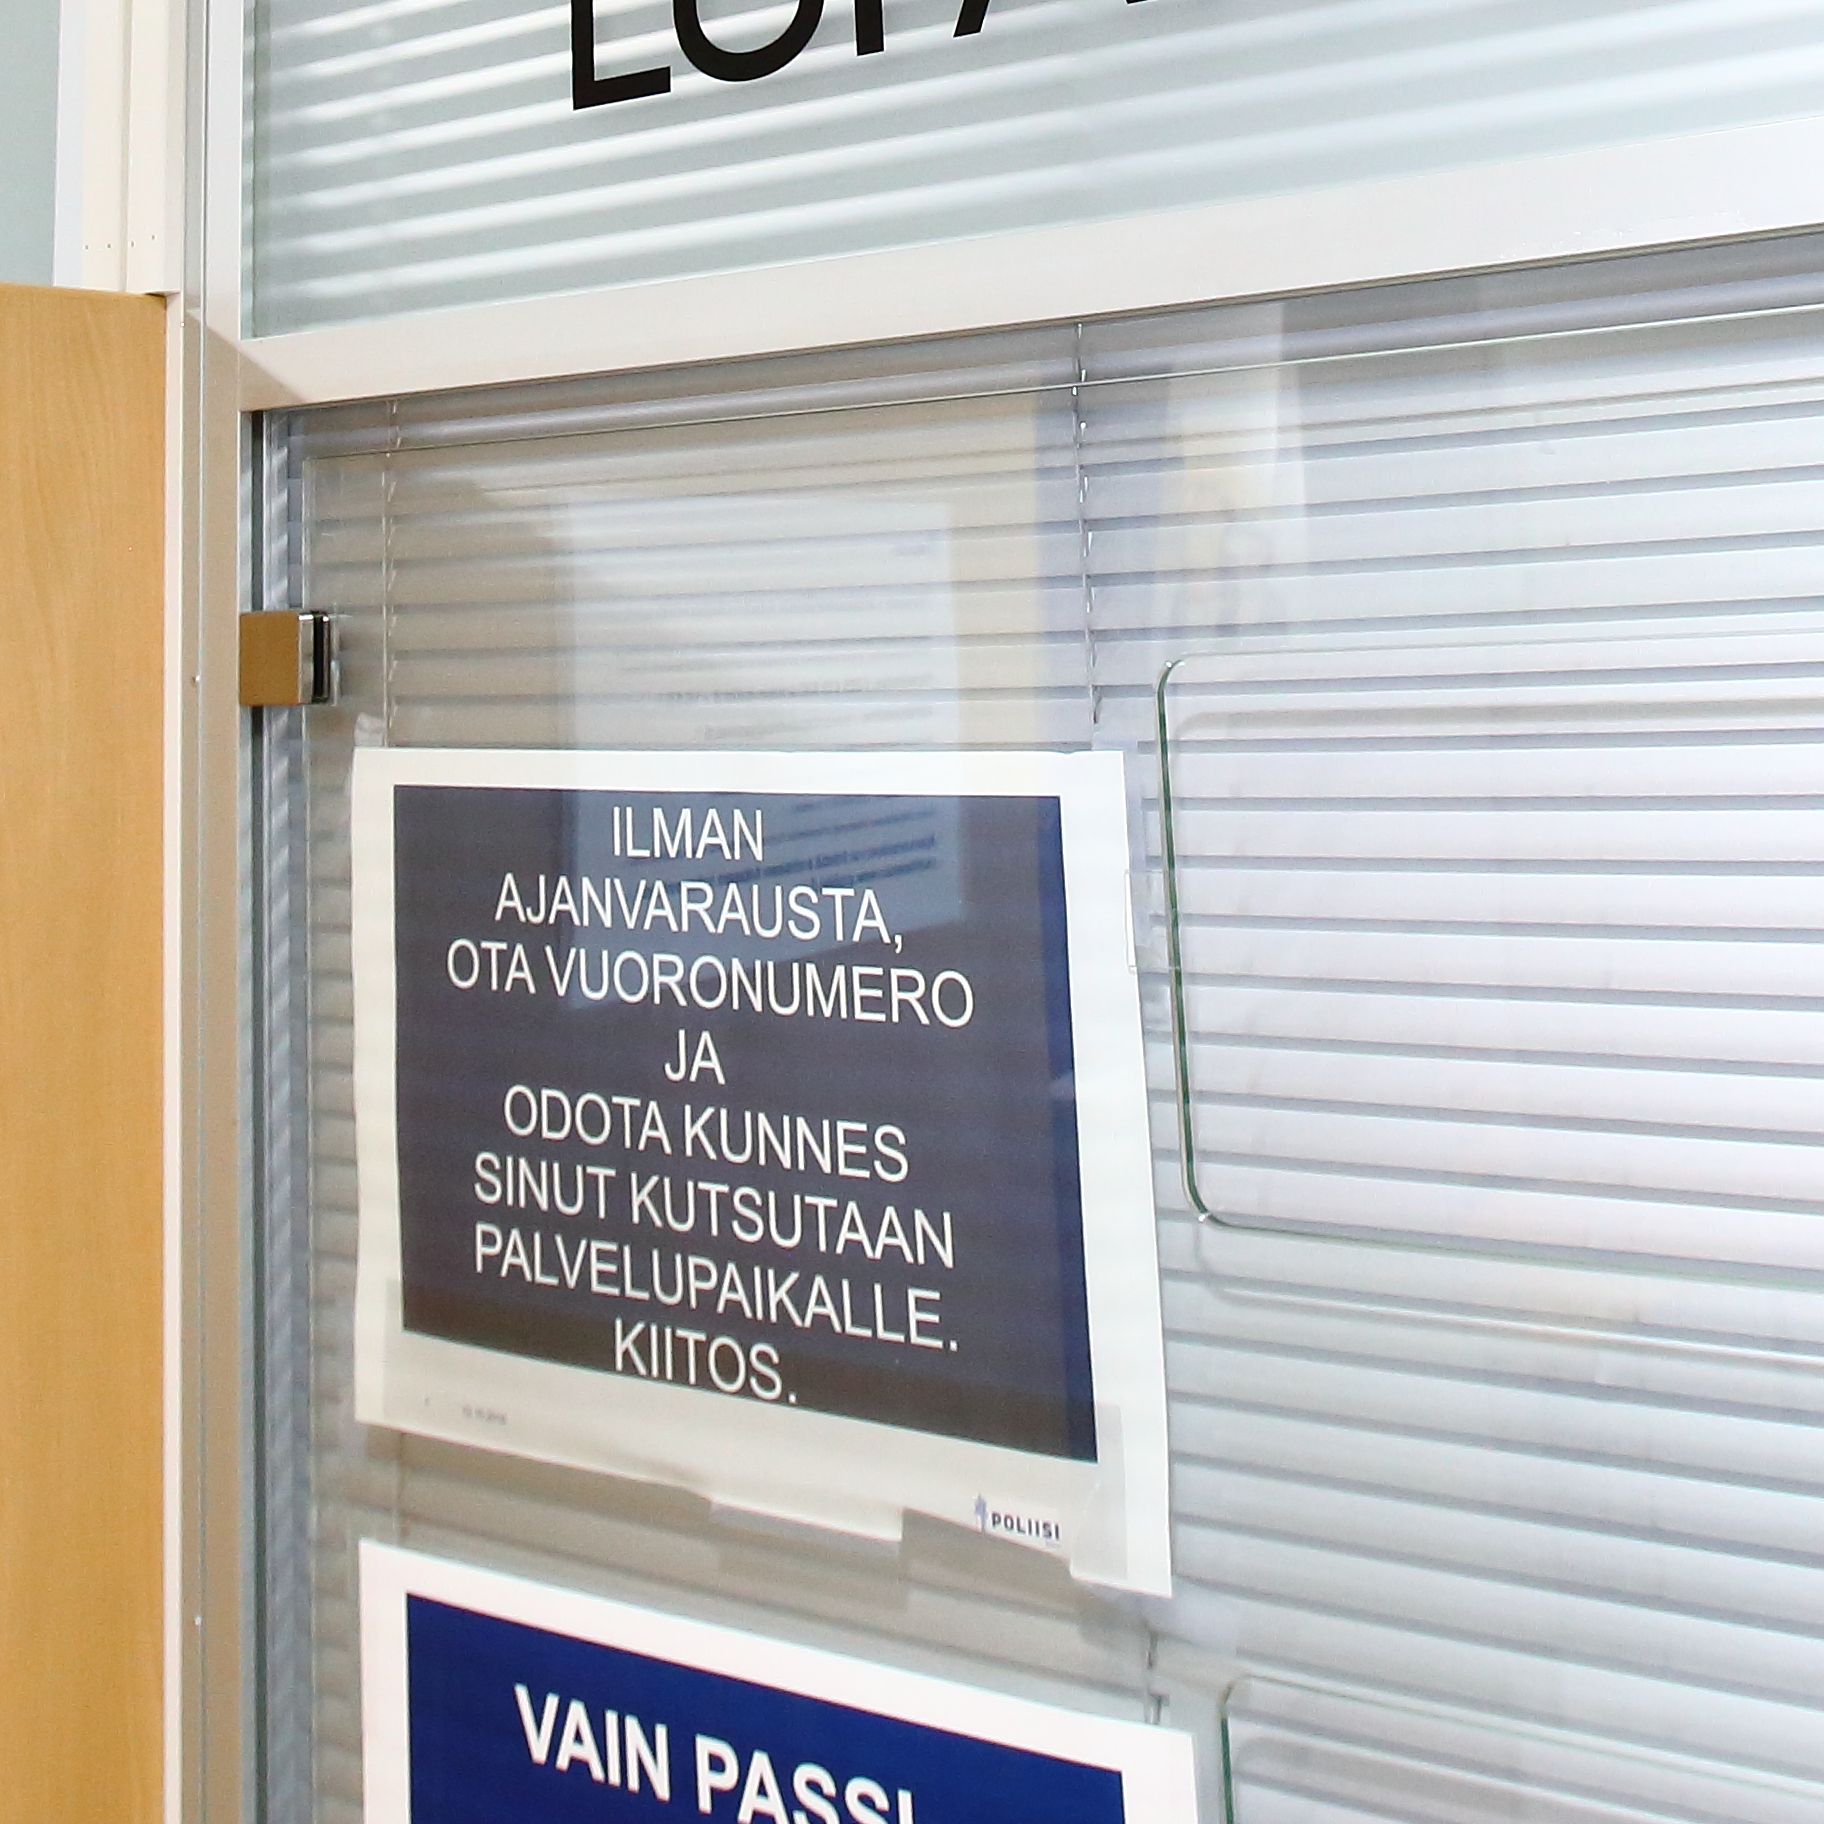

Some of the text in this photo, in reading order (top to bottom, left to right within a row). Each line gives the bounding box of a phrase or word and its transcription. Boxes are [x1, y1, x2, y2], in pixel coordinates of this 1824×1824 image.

[613, 806, 763, 861] ILMAN
[494, 872, 902, 954] AJANVARAUSTA,
[447, 938, 974, 1028] OTA VUORONUMERO
[664, 1029, 726, 1085] JA
[504, 1084, 909, 1183] ODOTA KUNNES
[474, 1151, 954, 1269] SINUT KUTSUTAAN
[475, 1222, 958, 1352] PALVELUPAIKALLE.
[615, 1317, 795, 1402] KIITOS.
[991, 1511, 1060, 1541] POLIISI
[514, 1683, 671, 1802] VAIN
